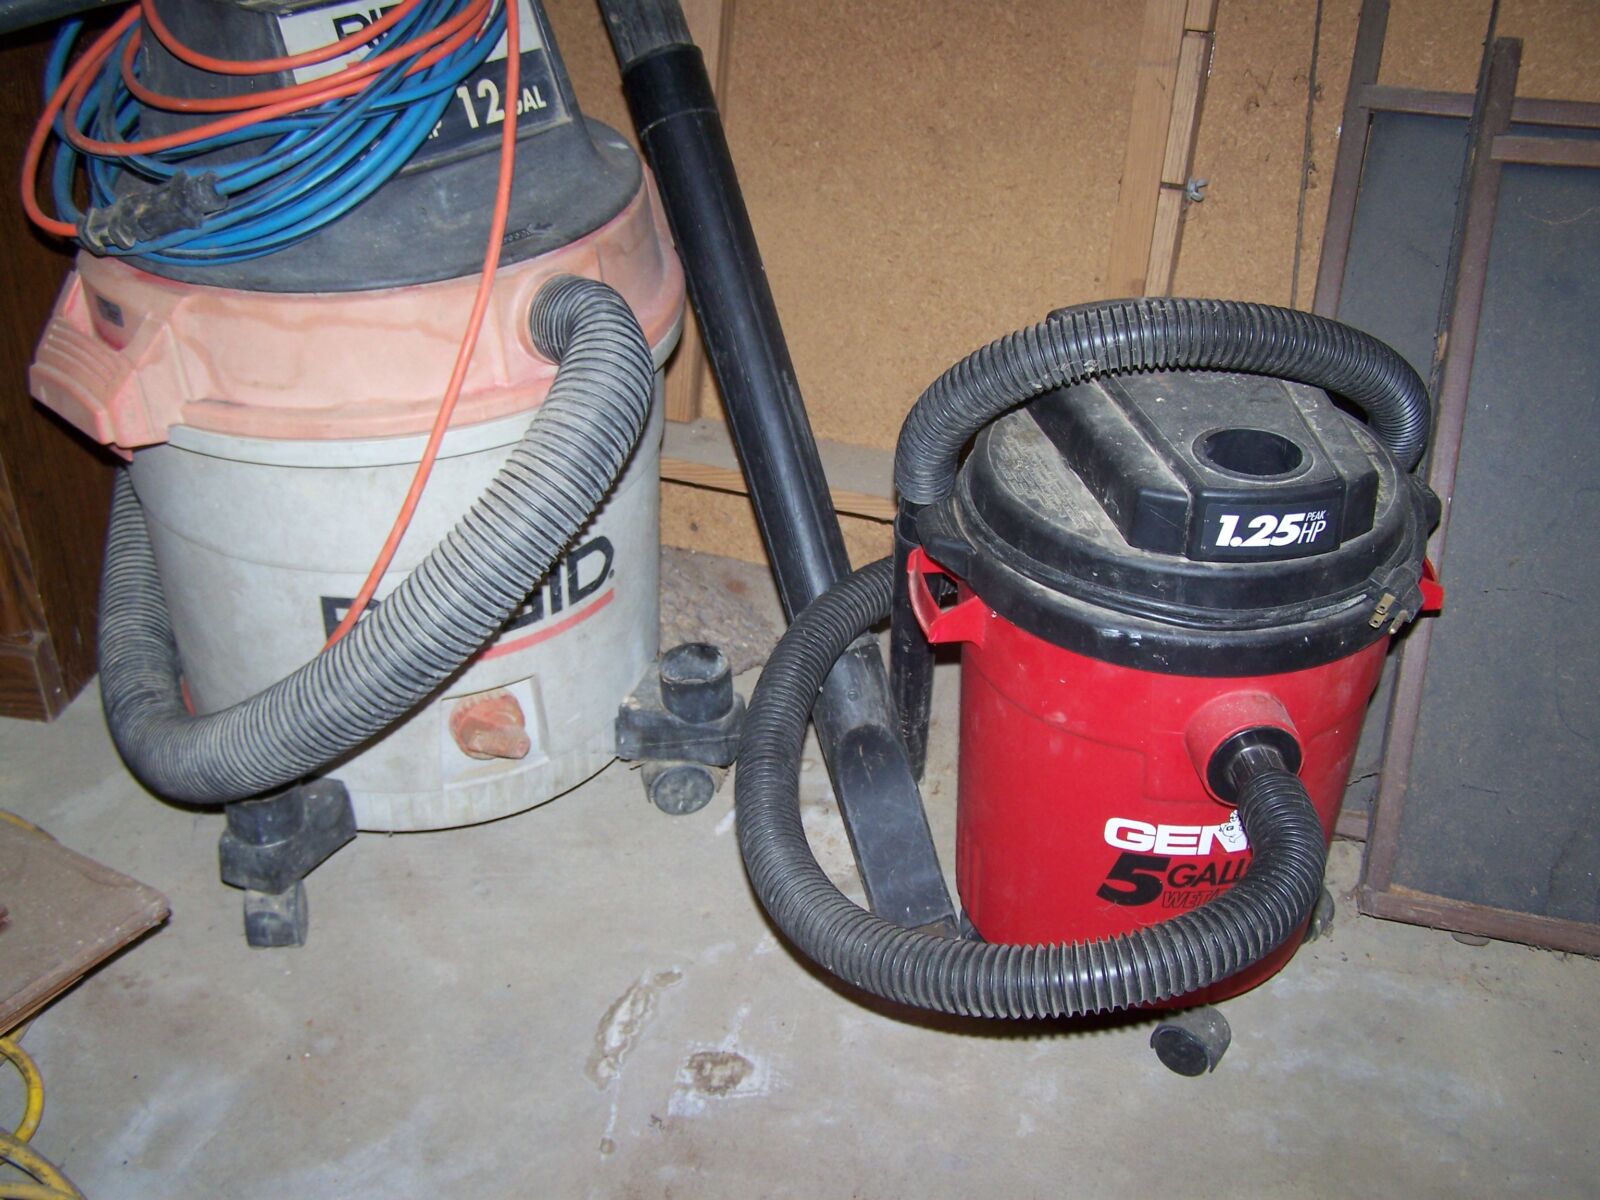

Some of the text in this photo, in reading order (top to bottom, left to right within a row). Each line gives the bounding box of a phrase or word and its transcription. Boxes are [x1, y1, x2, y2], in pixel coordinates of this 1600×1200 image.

[456, 78, 547, 129] 12 AL
[1215, 513, 1327, 547] 1.25 HP
[1306, 510, 1327, 521] PEAK
[1103, 817, 1249, 856] GEN
[1096, 852, 1250, 907] 5 GALL
